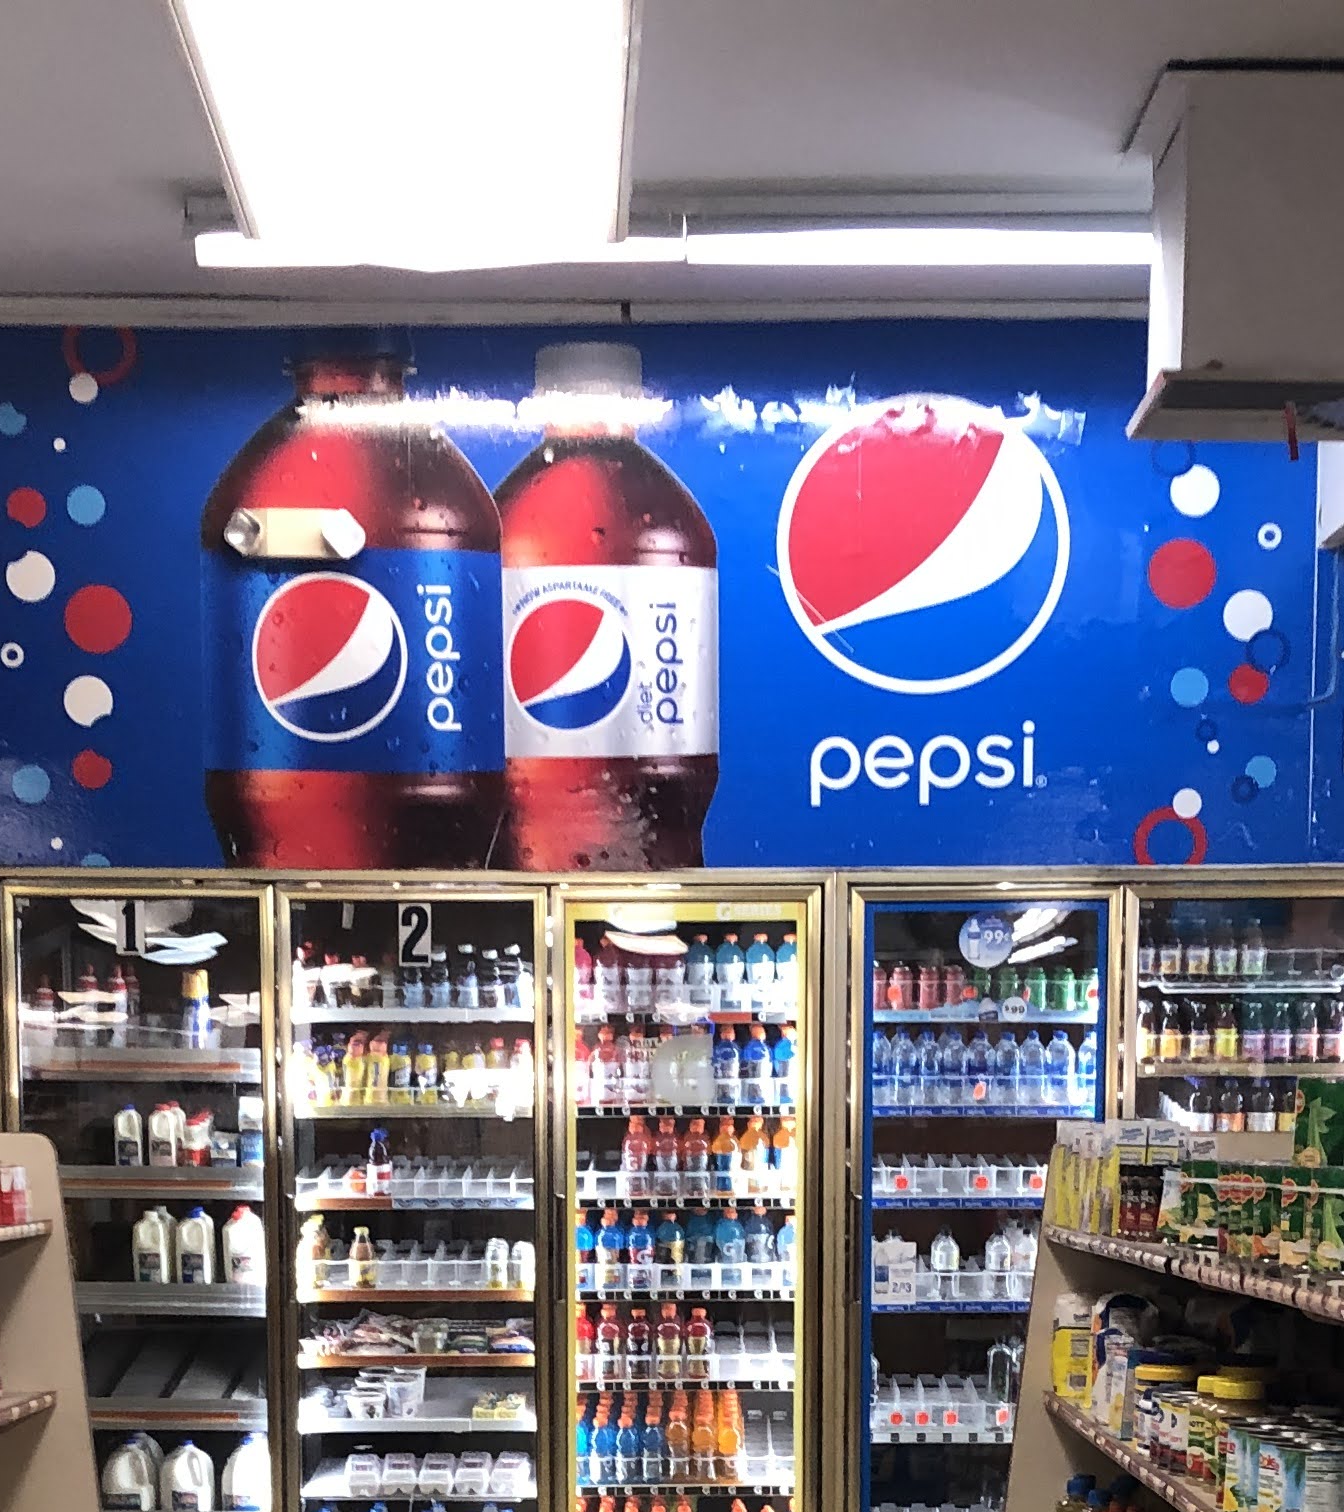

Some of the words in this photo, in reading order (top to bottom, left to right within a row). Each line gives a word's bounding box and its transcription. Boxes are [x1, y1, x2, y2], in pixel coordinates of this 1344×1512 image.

[425, 584, 461, 731] pepsi
[649, 602, 684, 725] pepsi
[637, 681, 653, 724] diet
[810, 720, 1036, 806] pepsi
[120, 903, 138, 954] 1
[400, 905, 430, 964] 2
